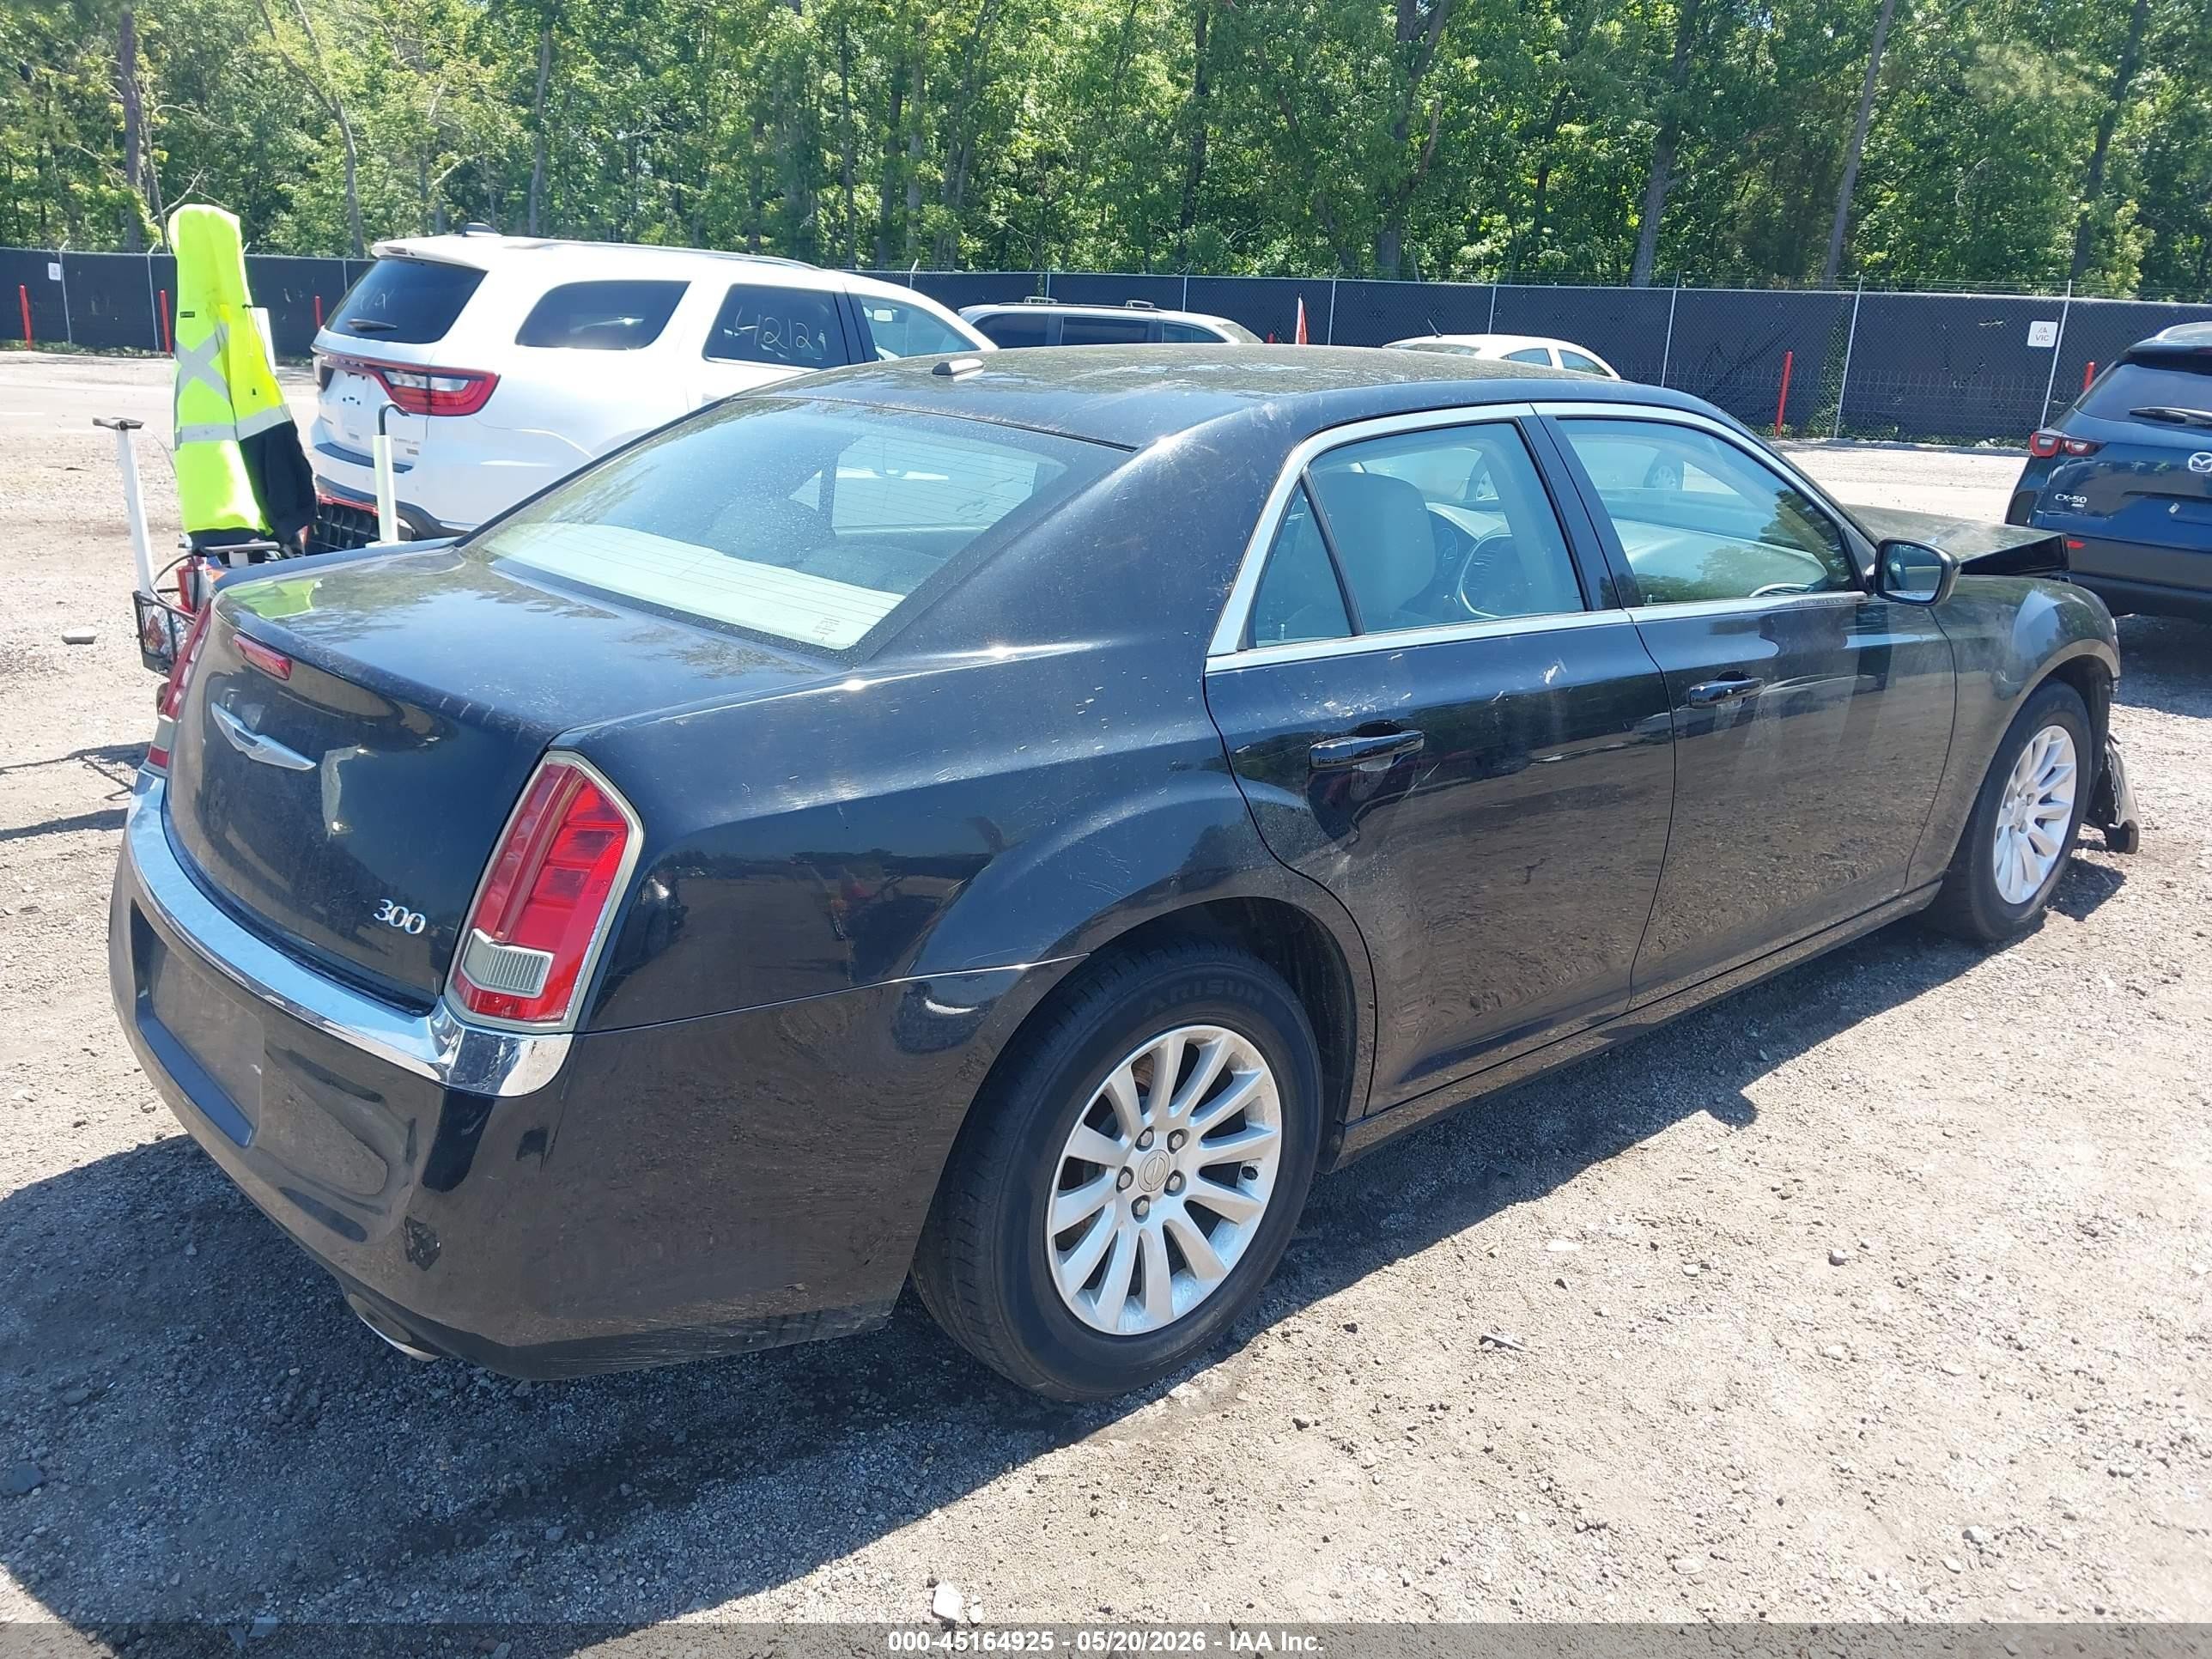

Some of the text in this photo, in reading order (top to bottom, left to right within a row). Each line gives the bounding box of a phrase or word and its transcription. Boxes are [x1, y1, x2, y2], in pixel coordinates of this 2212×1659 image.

[734, 307, 814, 350] 4212
[2054, 493, 2087, 503] CX-50
[373, 898, 426, 934] 300
